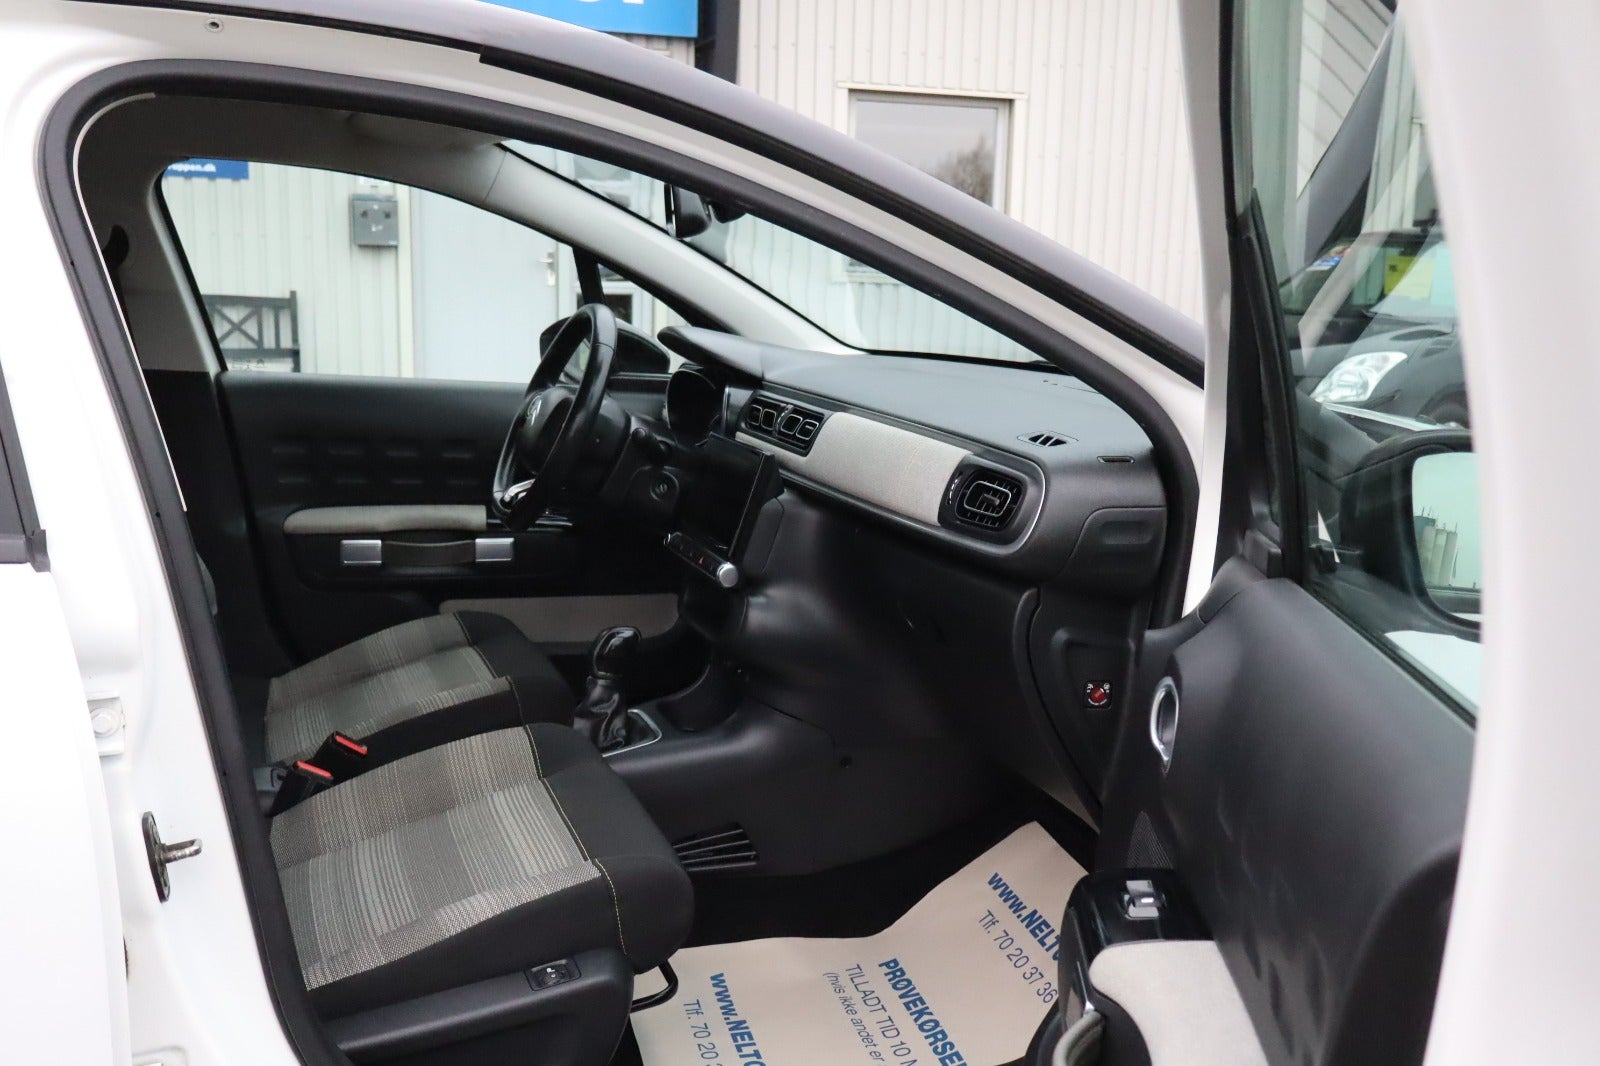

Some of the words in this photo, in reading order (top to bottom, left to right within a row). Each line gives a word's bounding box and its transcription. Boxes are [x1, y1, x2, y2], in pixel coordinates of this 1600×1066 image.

[979, 909, 999, 934] Tlf.
[993, 929, 1014, 950] 70
[1006, 947, 1029, 968] 20
[1022, 966, 1044, 984] 37
[1036, 981, 1058, 1003] 36
[987, 872, 1063, 961] www.NELT
[683, 999, 704, 1019] Tlf.
[691, 1022, 711, 1039] 70
[697, 1042, 719, 1060] 20
[822, 972, 845, 994] (hvis
[839, 995, 857, 1016] ikke
[851, 1017, 877, 1048] andet
[869, 1050, 885, 1062] er
[845, 963, 887, 1013] TILLADT
[876, 1015, 900, 1039] TID
[890, 1041, 911, 1057] 10
[878, 958, 967, 1066] PRØVEKØRSE
